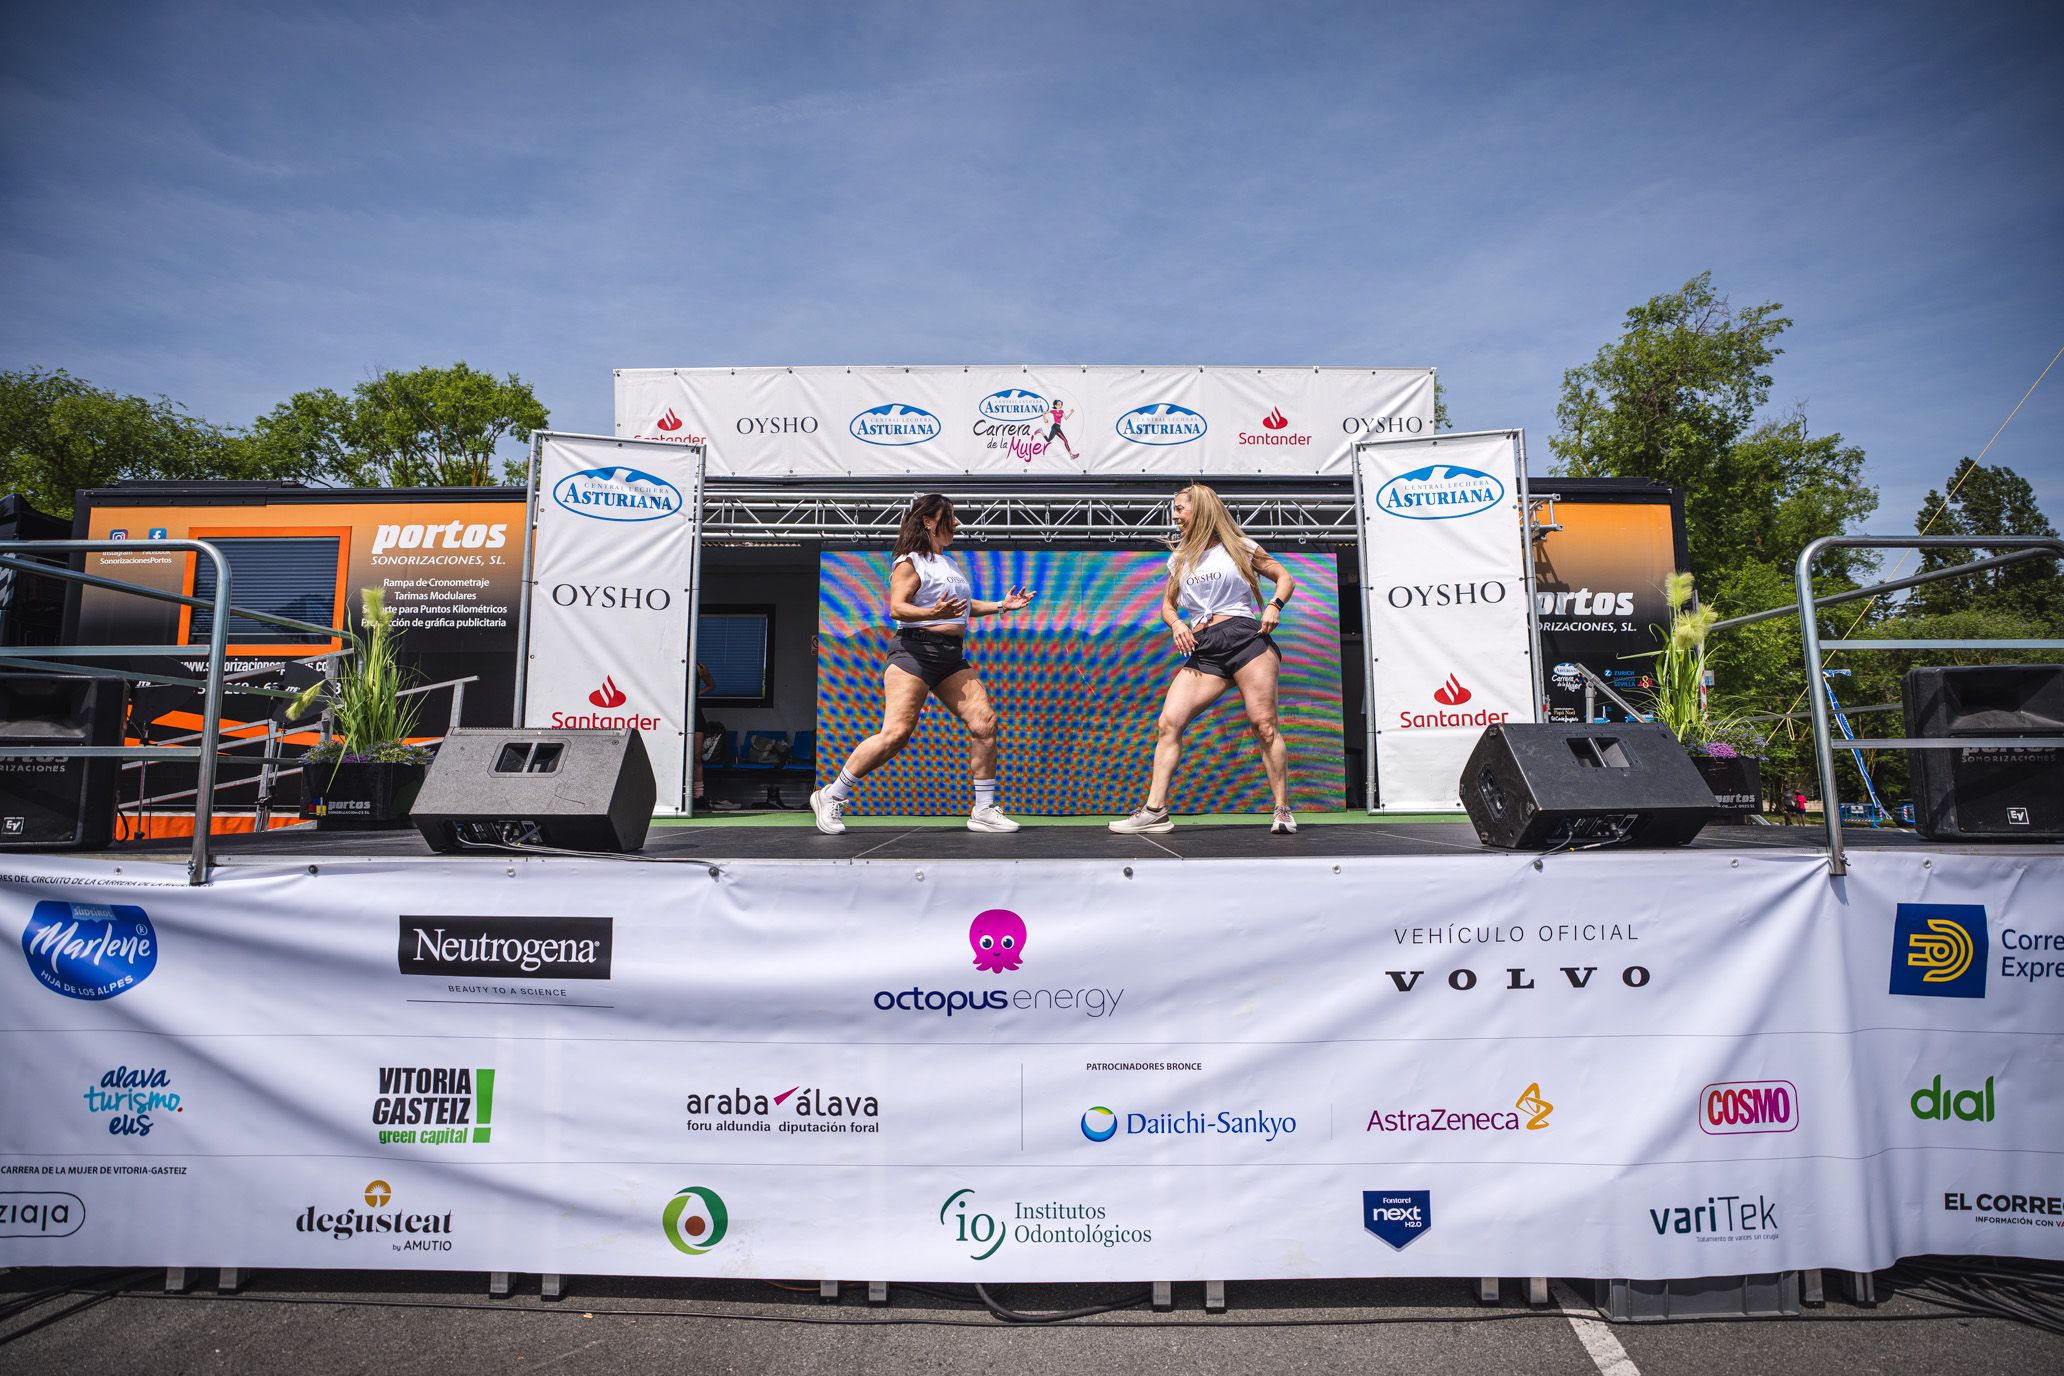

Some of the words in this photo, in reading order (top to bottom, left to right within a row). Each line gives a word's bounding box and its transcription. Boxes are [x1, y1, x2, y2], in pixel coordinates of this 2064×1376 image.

[985, 401, 1044, 414] ASTURIANA
[736, 416, 818, 434] OYSHO
[857, 419, 934, 435] ASTURIANA
[973, 420, 1031, 436] Carrera
[1123, 418, 1200, 434] ASTURIANA
[1342, 416, 1422, 434] OYSHO
[1239, 432, 1312, 446] Santander
[987, 438, 998, 448] de
[1000, 438, 1008, 448] la
[1007, 435, 1051, 462] Mujer
[584, 482, 624, 492] CENTRAL
[628, 486, 670, 494] LECHERA
[1448, 480, 1490, 488] LECHERA
[562, 482, 674, 510] ASTURIANA
[1386, 488, 1495, 508] ASTURIANA
[372, 520, 508, 555] portos
[100, 557, 172, 565] SonorizacionesPortos
[370, 556, 484, 566] SONORIZACIONES,
[489, 556, 506, 565] SL.
[384, 578, 414, 588] Rampa
[416, 578, 428, 586] de
[428, 578, 490, 588] Cronometraje
[1186, 572, 1222, 586] OYSHO
[395, 592, 428, 600] Tarimas
[430, 592, 476, 600] Modulares
[552, 584, 670, 610] OYSHO
[1388, 580, 1506, 608] OYSHO
[1536, 588, 1634, 616] ortos
[399, 606, 418, 616] para
[420, 605, 450, 614] Puntos
[452, 604, 508, 614] Kilométricos
[412, 618, 424, 626] de
[424, 618, 455, 628] gráfica
[456, 618, 506, 628] publicitaria
[1538, 622, 1617, 633] ORIZACIONES,
[1621, 622, 1637, 632] SL.
[551, 712, 661, 730] Santander
[1400, 709, 1509, 728] Santander
[0, 764, 66, 772] RIZACIONES
[328, 800, 370, 811] portos
[15, 875, 30, 884] DEL
[32, 876, 71, 885] CIRCUITO
[1394, 923, 1524, 944] VEHÍCULO
[1538, 924, 1638, 942] OFICIAL
[2002, 928, 2064, 950] Corre
[30, 921, 150, 974] Marlene
[413, 928, 596, 972] Neutrogena
[2002, 956, 2064, 982] Expre
[40, 970, 62, 988] HIJA
[64, 983, 76, 994] DE
[78, 988, 96, 996] LOS
[98, 975, 134, 996] ALPES
[1385, 966, 1650, 992] VOLVO
[448, 985, 488, 994] BEAUTY
[520, 988, 567, 997] SCIENCE
[874, 986, 1008, 1016] octopus
[1012, 988, 1124, 1018] energy
[1086, 1062, 1165, 1071] PATROCINADORES
[1166, 1062, 1202, 1071] BRONCE
[100, 1066, 170, 1088] alava
[379, 1068, 472, 1094] VITORIA
[372, 1097, 471, 1124] GASTEIZ
[686, 1088, 769, 1116] araba
[796, 1088, 879, 1117] álava
[1708, 1087, 1790, 1126] COSMO
[109, 1114, 154, 1136] eus
[687, 1120, 712, 1131] foru
[716, 1120, 771, 1132] aldundia
[778, 1121, 846, 1134] diputación
[850, 1122, 879, 1133] foral
[1127, 1110, 1296, 1142] Daiichi-Sankyo
[1366, 1109, 1520, 1132] AstraZeneca
[378, 1130, 416, 1144] green
[420, 1128, 468, 1146] capital
[1, 1166, 40, 1174] CARRERA
[42, 1166, 54, 1174] DE
[55, 1166, 66, 1174] LA
[68, 1166, 98, 1174] MUJER
[100, 1166, 112, 1174] DE
[114, 1166, 187, 1175] VITORIA-GASTEIZ
[1014, 1202, 1106, 1220] Institutos
[1373, 1206, 1422, 1220] next
[1944, 1192, 1972, 1210] EL
[1976, 1194, 2064, 1216] CORRE
[296, 1206, 454, 1240] degusteat
[1650, 1195, 1778, 1235] variTek
[1976, 1216, 2032, 1226] INFORMACIÓN
[1014, 1224, 1152, 1248] Odontológicos
[392, 1244, 400, 1252] by
[404, 1240, 452, 1251] AMUTIO
